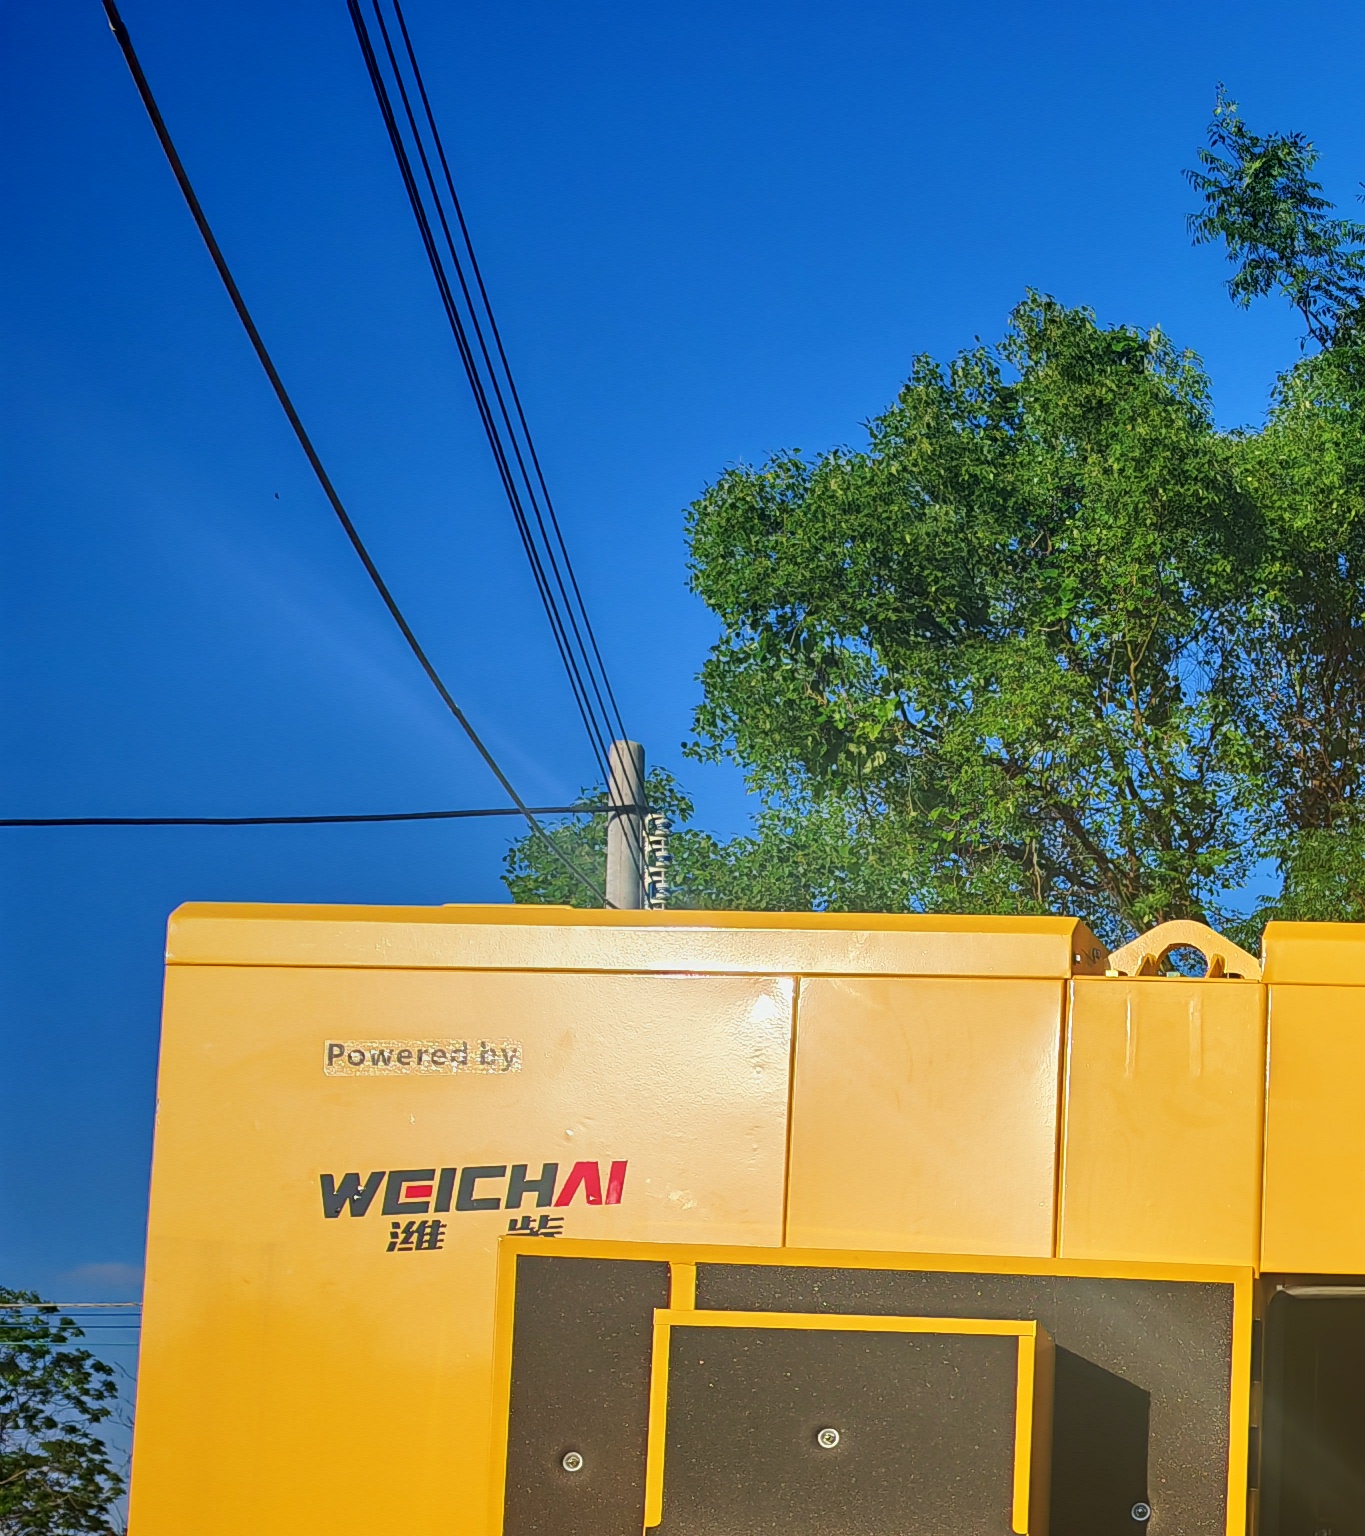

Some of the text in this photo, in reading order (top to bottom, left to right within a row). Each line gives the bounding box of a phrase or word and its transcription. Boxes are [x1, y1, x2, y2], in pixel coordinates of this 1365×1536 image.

[327, 1040, 518, 1073] Powered by
[320, 1160, 628, 1219] WEICHAI
